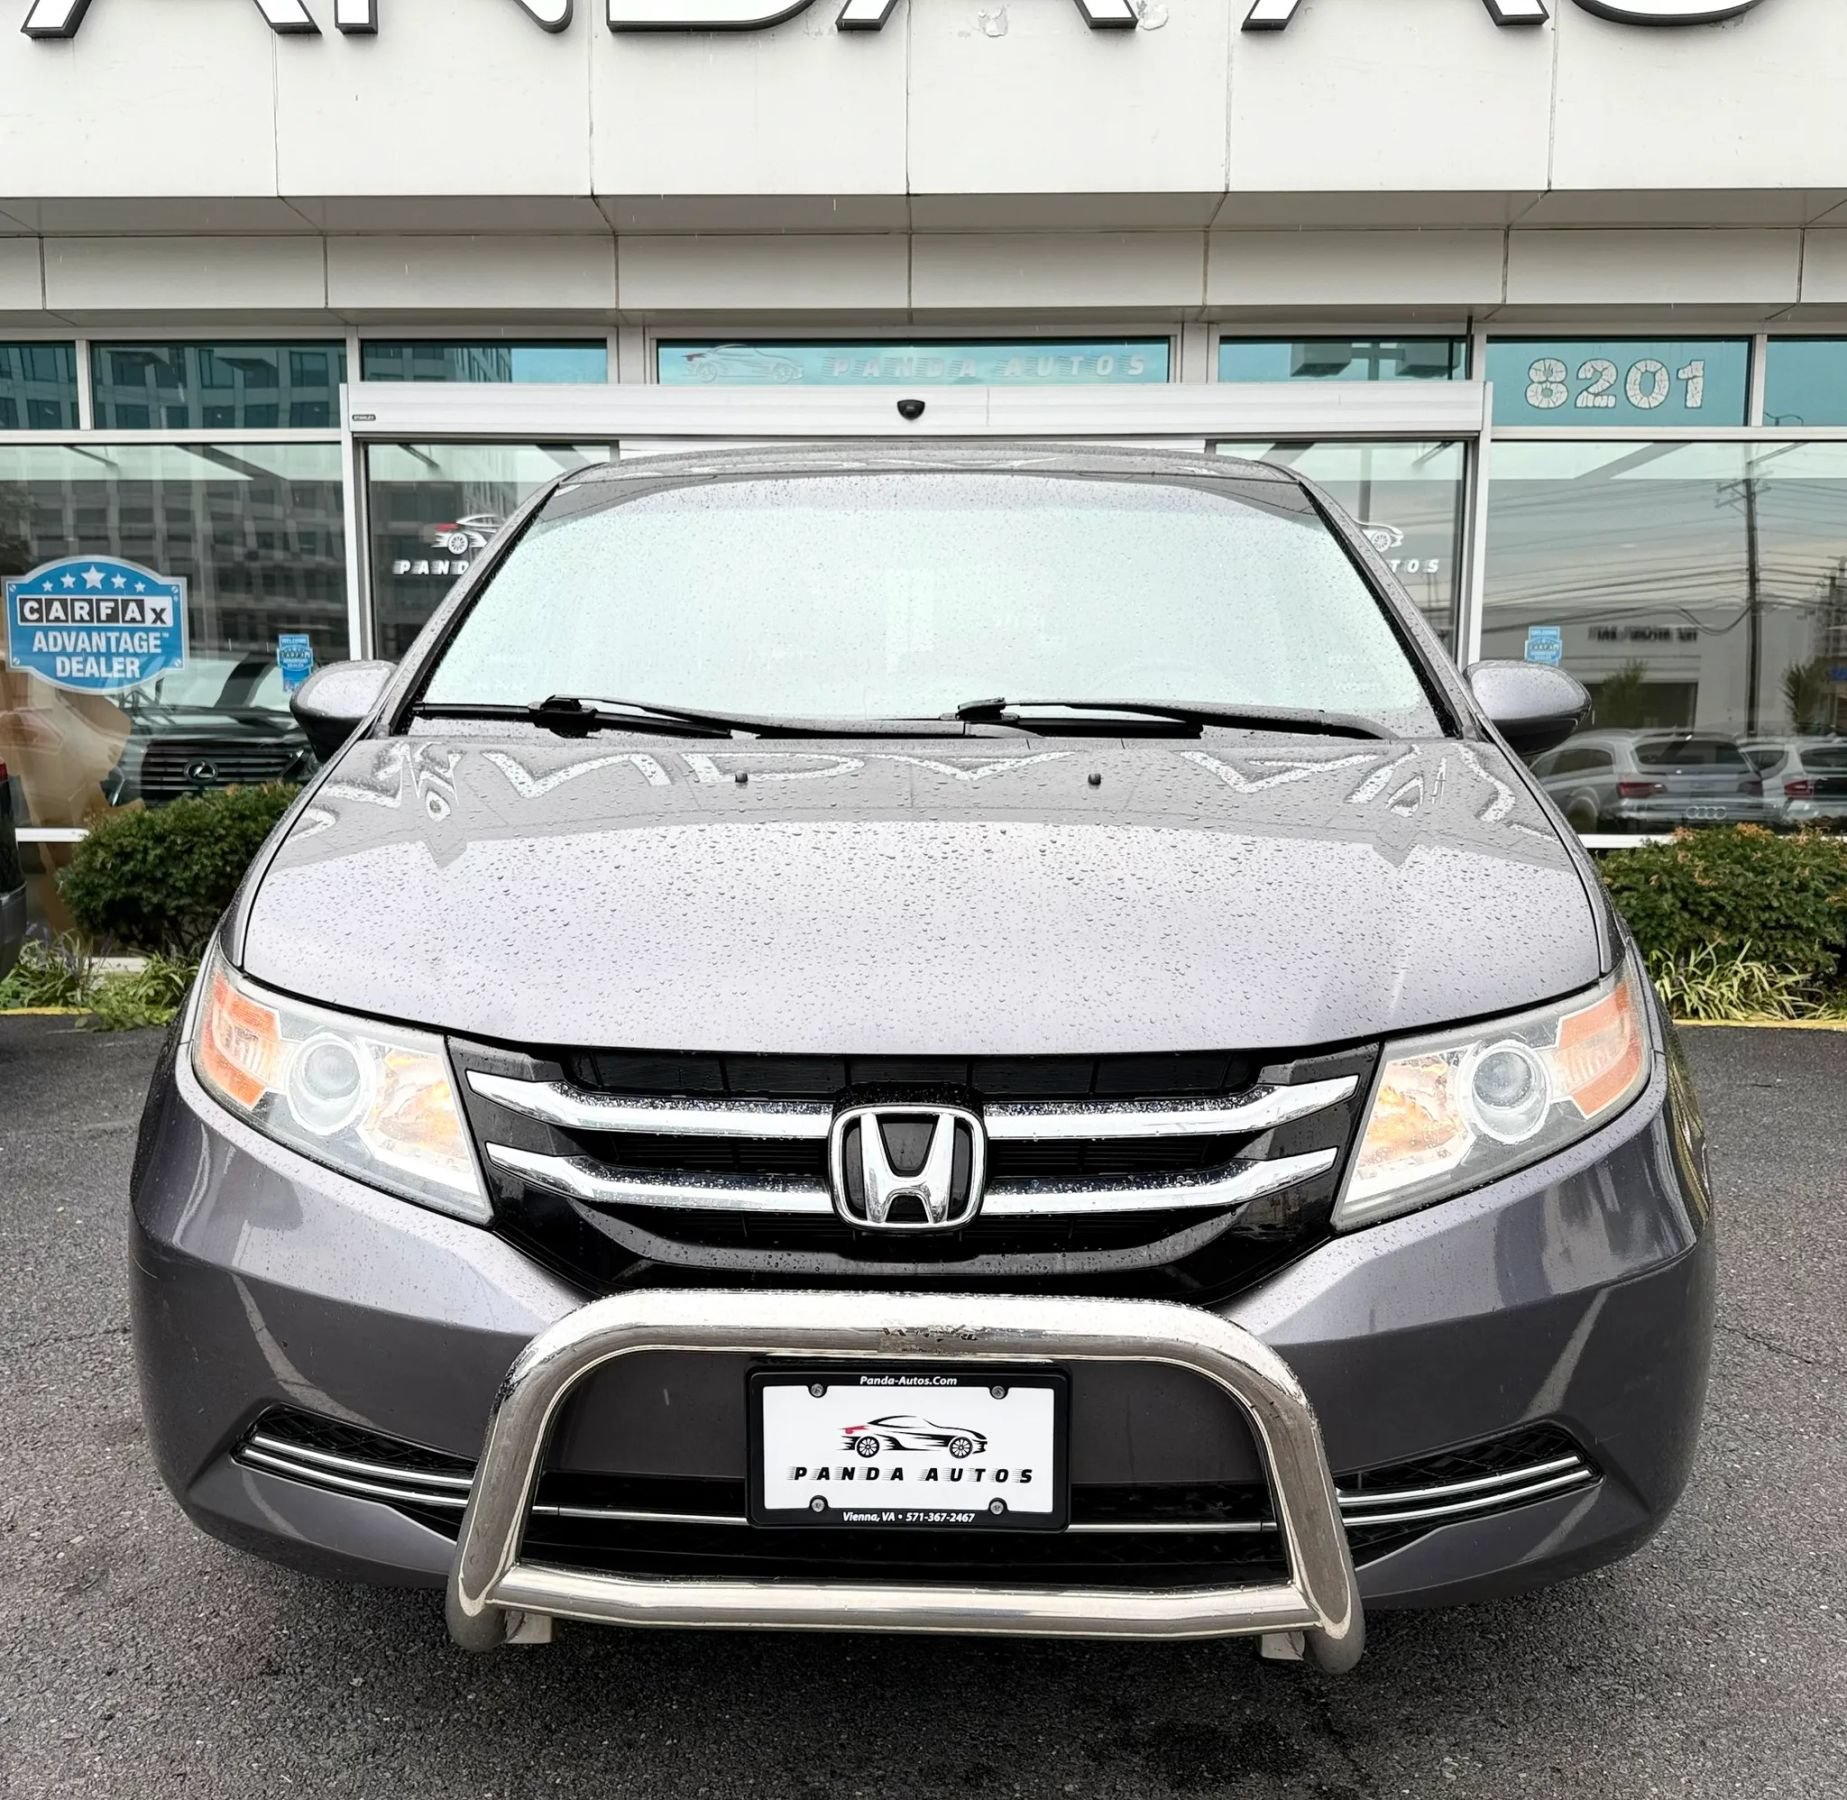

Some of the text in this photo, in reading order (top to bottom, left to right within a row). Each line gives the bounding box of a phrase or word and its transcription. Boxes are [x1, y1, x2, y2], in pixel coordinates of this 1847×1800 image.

[828, 354, 1147, 378] PANDA AUTOS
[1525, 357, 1705, 409] 8201
[394, 559, 1439, 575] PAND TOS
[21, 599, 168, 625] CARFAX
[33, 630, 162, 653] ADVANTAGE
[56, 656, 141, 678] DEALER
[859, 1375, 958, 1386] Panda-Autos.Com
[791, 1466, 1033, 1483] PANDA AUTOS
[842, 1511, 976, 1523] Vienna, VA 571-367-2467
